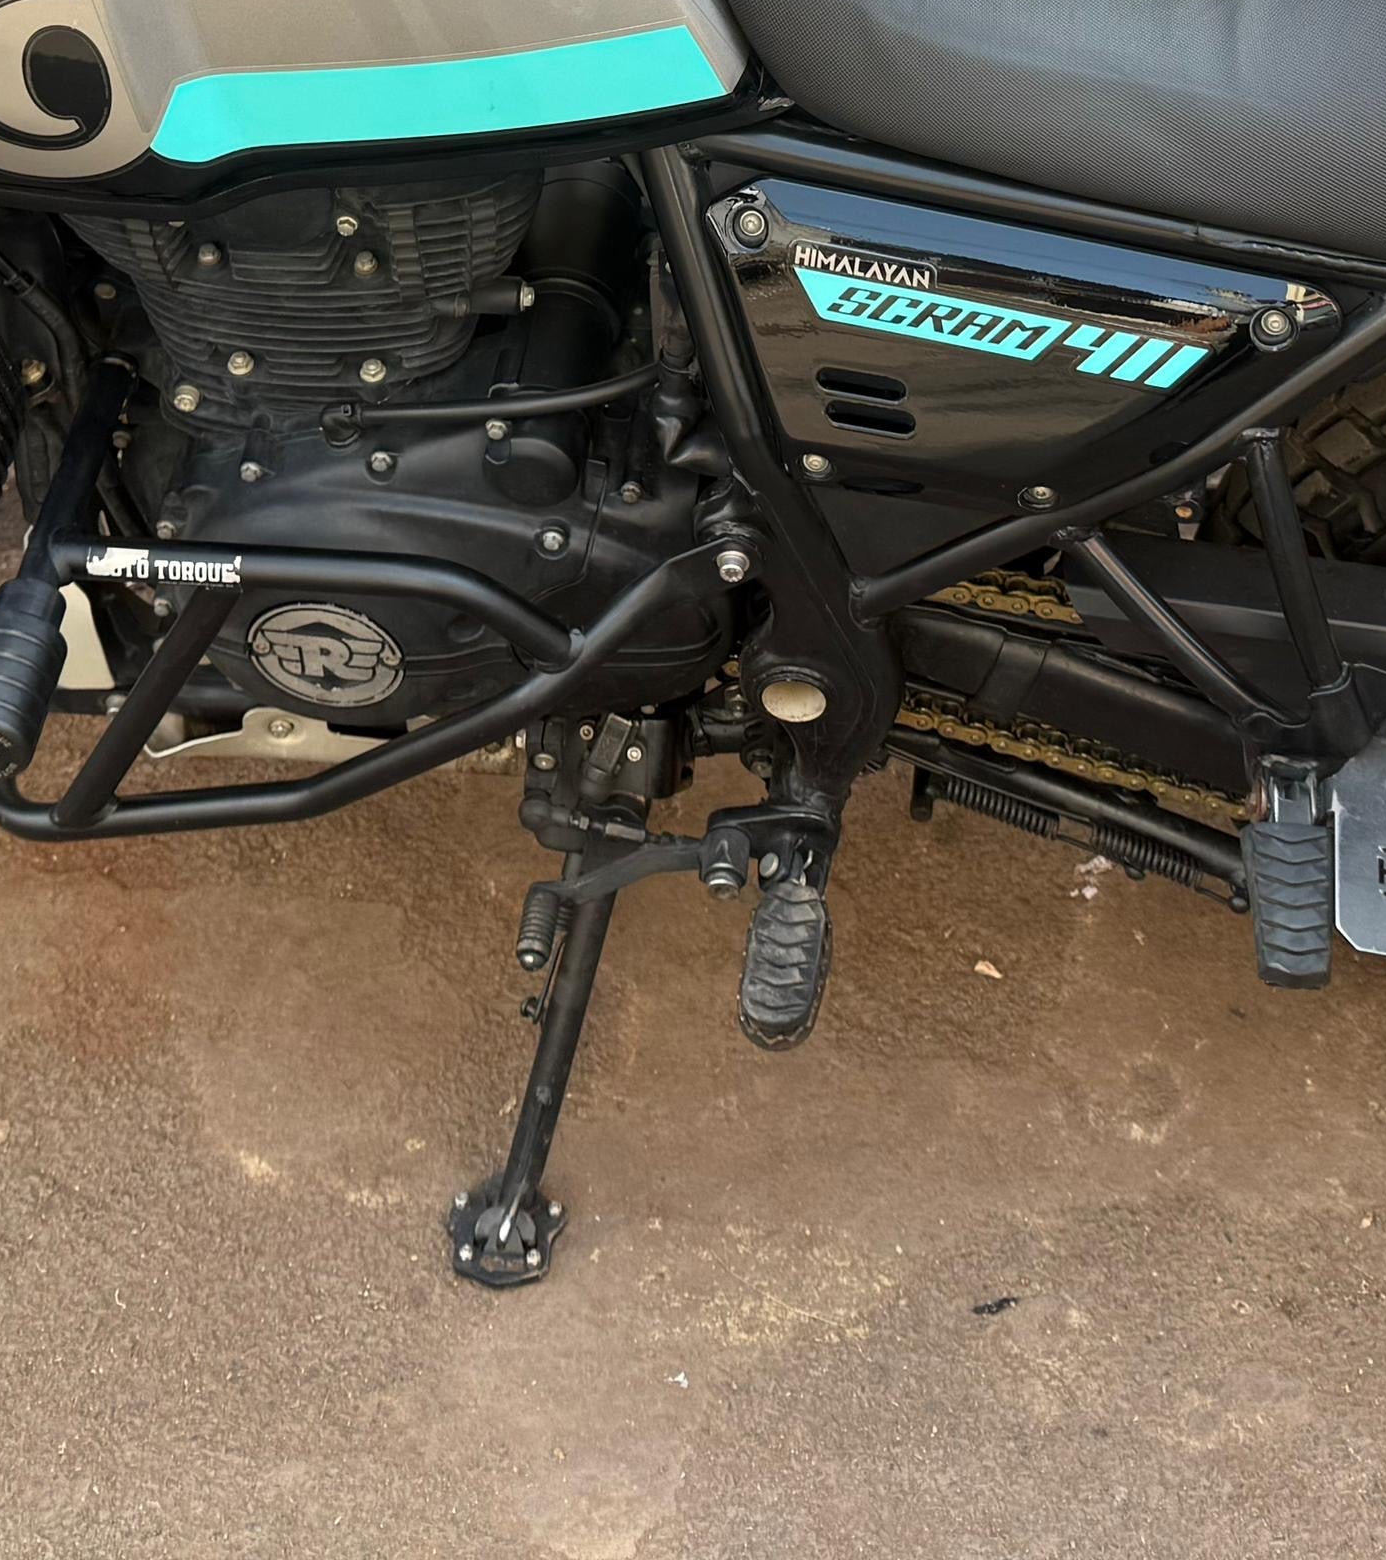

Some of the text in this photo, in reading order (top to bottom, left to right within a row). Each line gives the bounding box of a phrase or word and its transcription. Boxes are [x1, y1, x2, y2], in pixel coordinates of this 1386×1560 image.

[794, 245, 931, 289] HIMALAYAN
[827, 286, 1209, 389] SCRAM 411
[153, 559, 241, 584] TORQUE
